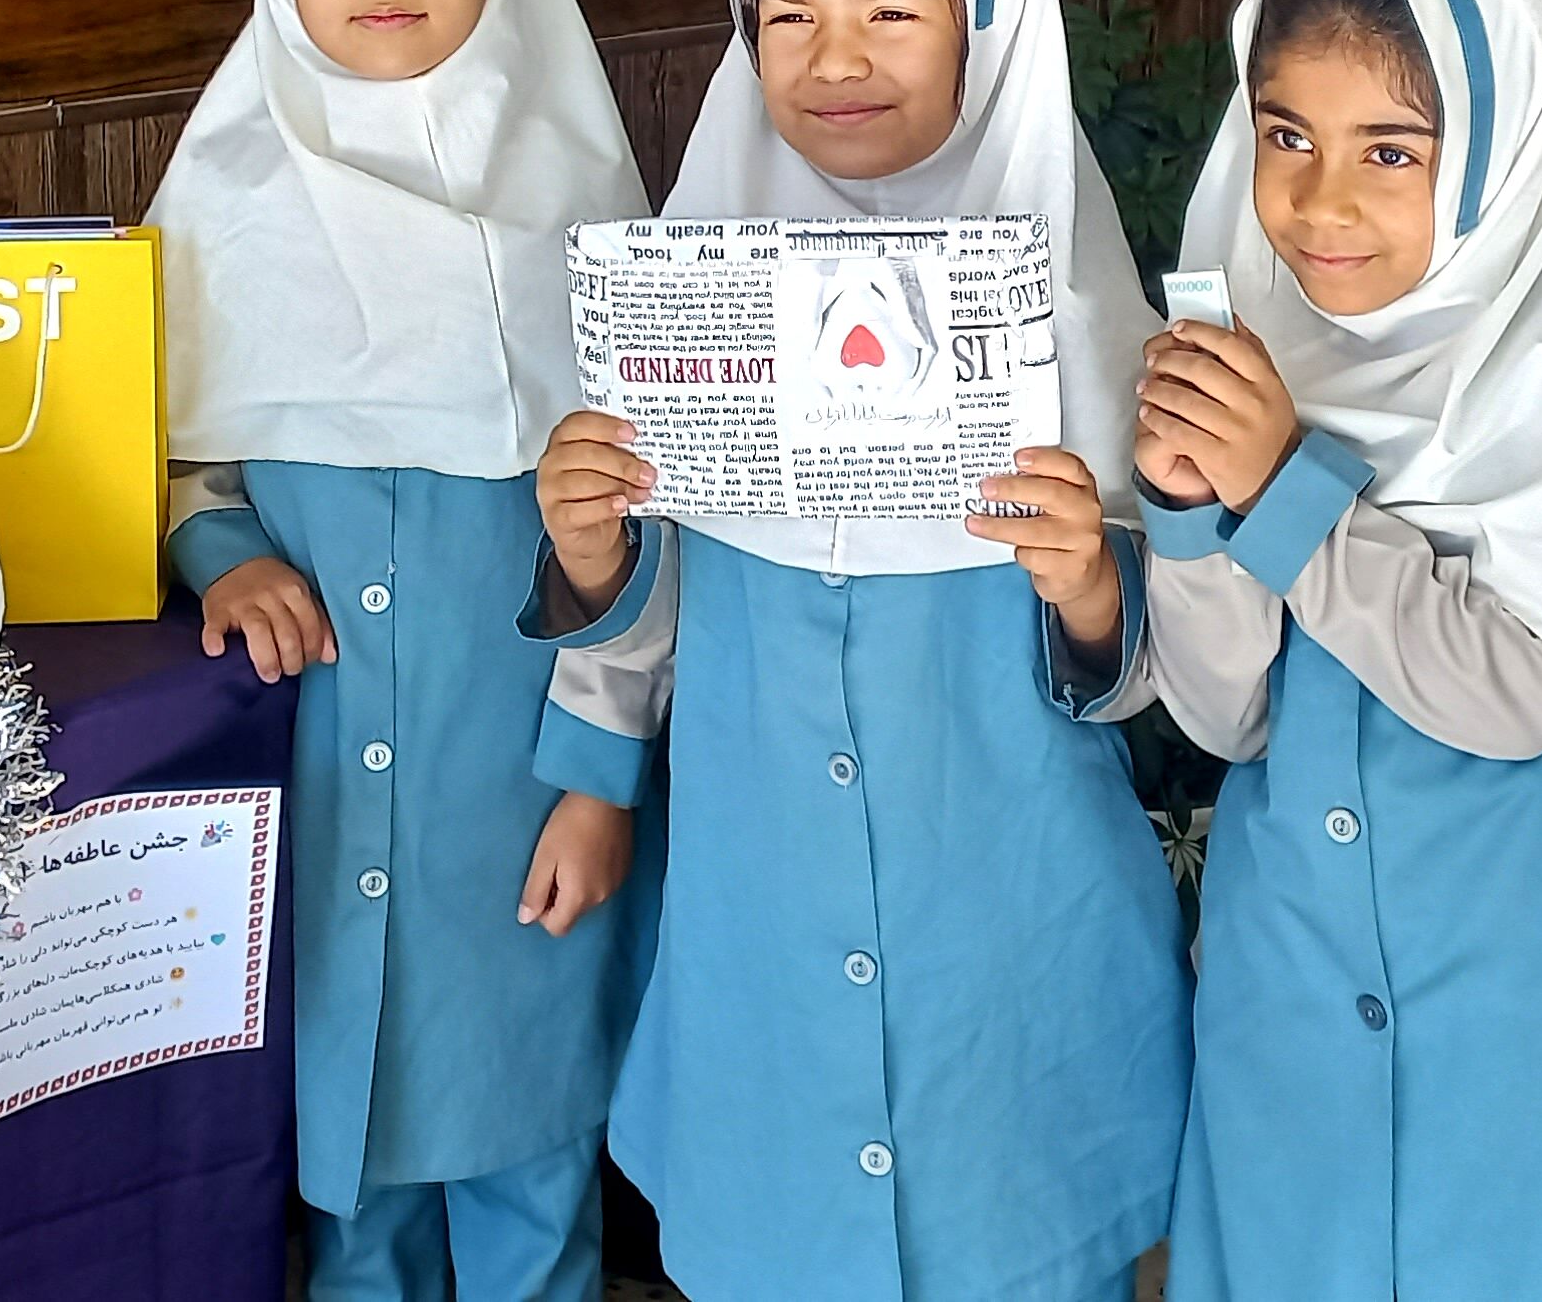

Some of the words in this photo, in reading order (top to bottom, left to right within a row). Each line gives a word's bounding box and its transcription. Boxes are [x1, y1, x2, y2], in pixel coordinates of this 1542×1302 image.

[625, 223, 652, 237] my
[666, 225, 724, 240] breath
[737, 221, 778, 236] your
[959, 229, 983, 241] are
[697, 245, 724, 261] my
[751, 248, 779, 260] are
[949, 271, 996, 284] words
[950, 290, 978, 304] this
[952, 335, 994, 382] IS
[619, 358, 715, 384] DEFINED
[719, 358, 776, 384] LOVE
[853, 469, 872, 477] you
[875, 469, 897, 477] love
[796, 482, 811, 490] my
[939, 477, 958, 486] you
[130, 832, 188, 860] جشن
[96, 898, 111, 912] هم
[115, 895, 121, 904] با
[59, 904, 92, 920] مهربان
[31, 912, 56, 933] باشیم
[131, 919, 160, 930] دست
[164, 916, 178, 927] هر
[90, 922, 128, 943] کوچکی
[31, 946, 47, 963] دلی
[167, 944, 173, 953] با
[2, 957, 17, 971] شاد
[135, 977, 164, 991] شادی
[20, 1007, 47, 1026] شادی
[134, 1009, 148, 1020] هم
[153, 1004, 162, 1016] تو
[54, 1021, 88, 1043] قهرمان
[15, 1037, 51, 1059] مهربانی
